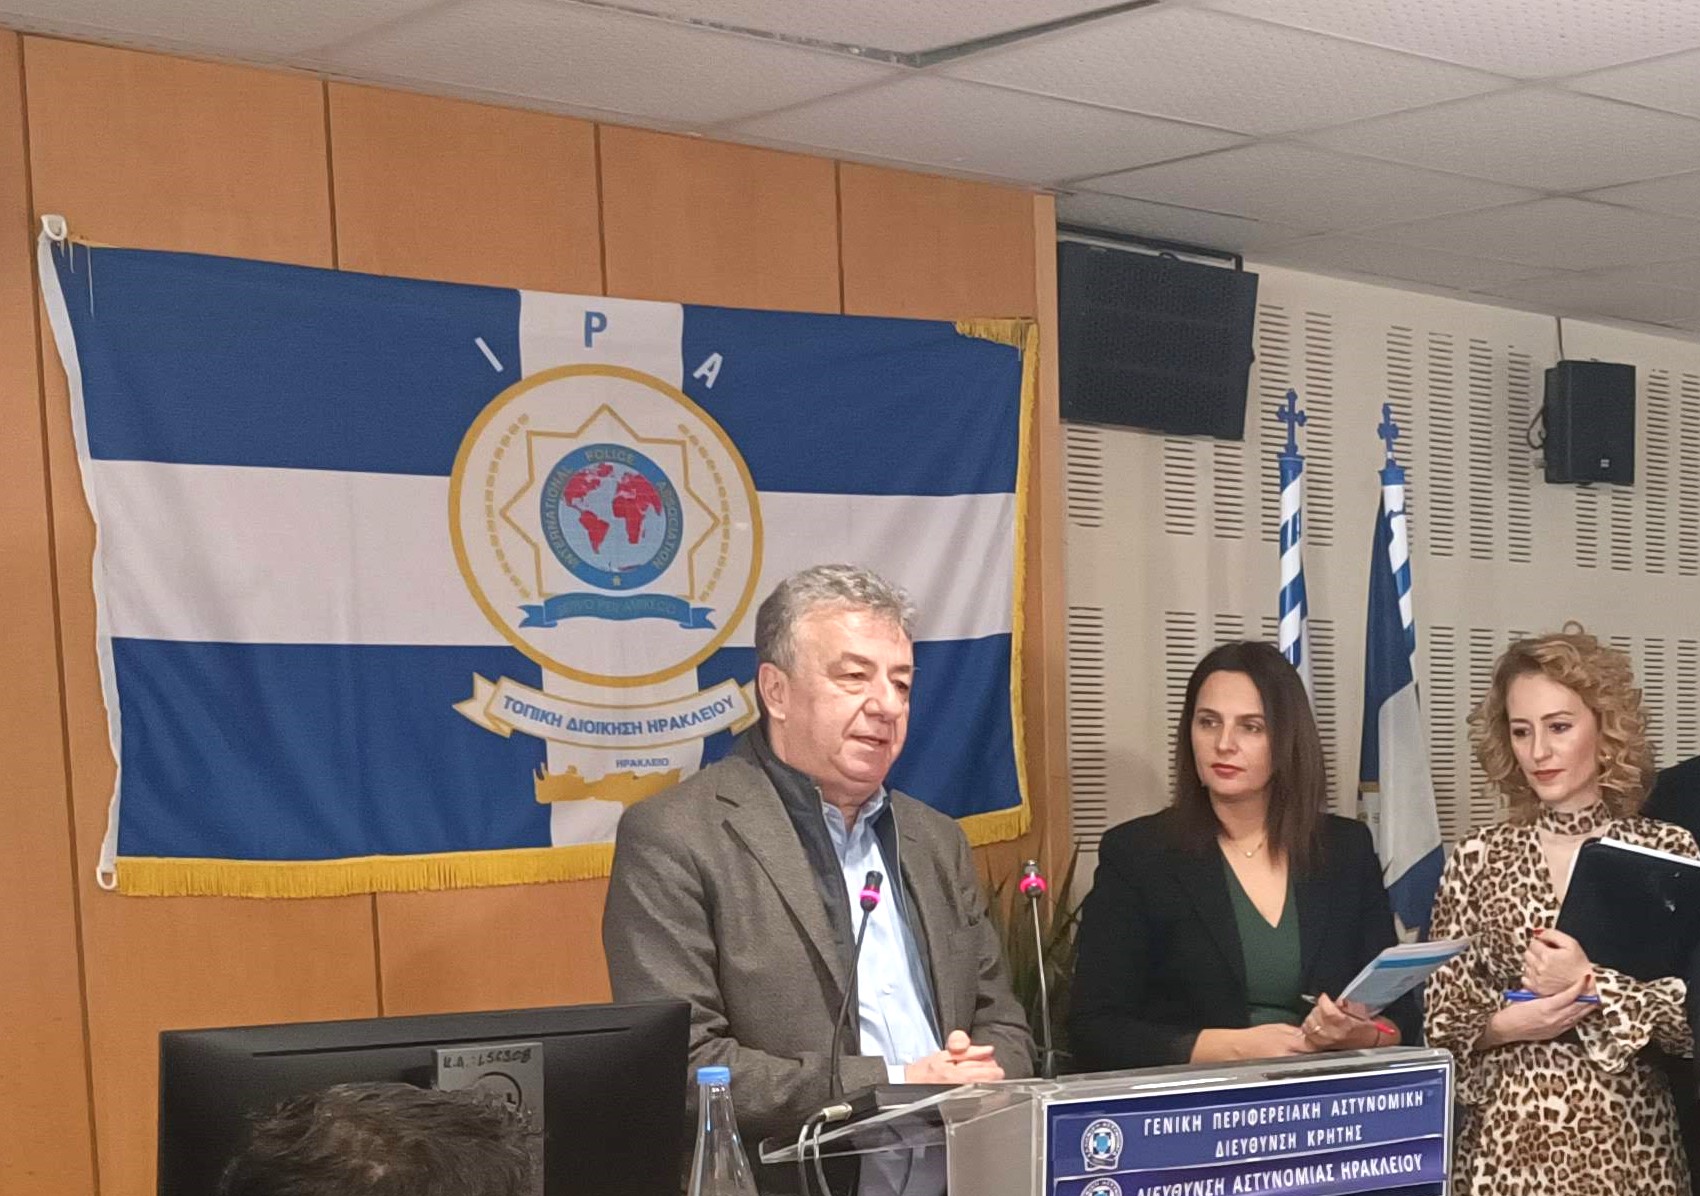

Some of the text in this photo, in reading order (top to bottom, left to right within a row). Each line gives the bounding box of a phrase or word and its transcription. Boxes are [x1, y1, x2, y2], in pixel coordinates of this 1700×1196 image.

[545, 466, 581, 569] INTERNATIONAL
[584, 449, 635, 464] POLICE
[651, 479, 680, 570] ASSOCIATION
[503, 695, 736, 735] ΤΟΠΙΚΗ ΔΙΟΙΚΗΣΗ ΗΡΑΚΛΕΙΟΥ
[616, 757, 670, 769] ΗΡΑΚΛΕΙΟ
[1144, 1090, 1424, 1136] ΓΕΝΙΚΗ ΠΕΡΙΦΕΡΕΙΑΚΗ ΑΣΤΥΝΟΜΙΚΗ
[1215, 1124, 1363, 1158] ΔΙΕΥΘΥΝΣΗ ΚΡΗΤΗΣ
[1232, 1163, 1335, 1195] ΑΣΤΥΝΟΜΙΑΣ
[1340, 1153, 1423, 1181] ΗΡΑΚΛΕΙΟΥ
